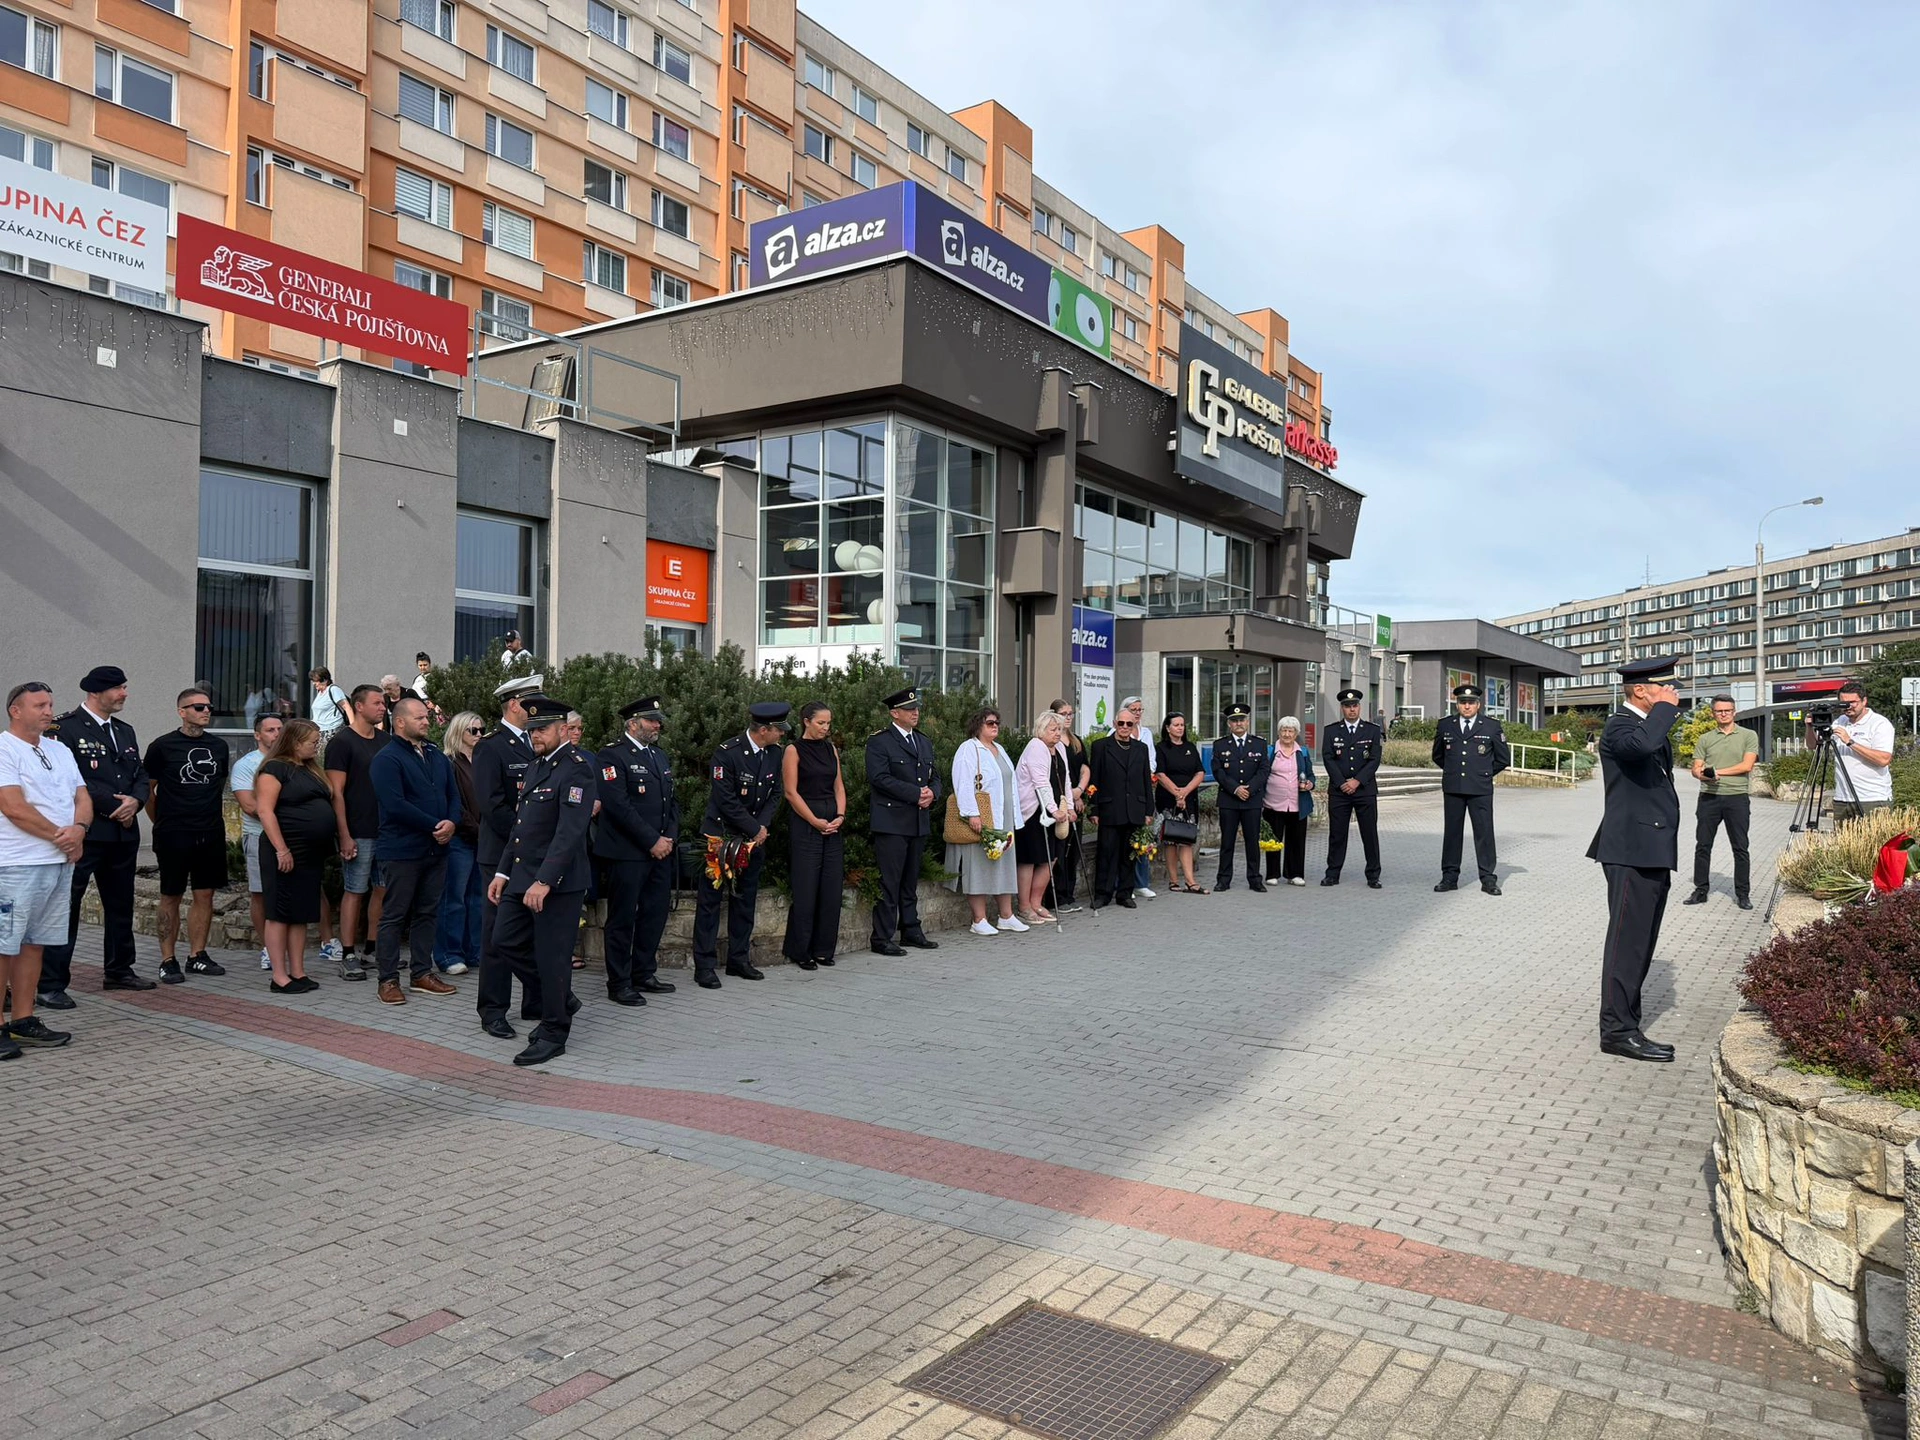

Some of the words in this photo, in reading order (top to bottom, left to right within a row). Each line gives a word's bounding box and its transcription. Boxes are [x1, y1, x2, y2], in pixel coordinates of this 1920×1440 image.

[0, 219, 82, 252] ZÁKAZNICKÉ
[86, 245, 145, 269] CENTRUM
[97, 208, 146, 247] ČEZ
[804, 218, 886, 256] alza.cz
[278, 266, 372, 311] GENERALI
[970, 245, 1025, 292] alza.cz
[277, 287, 340, 324] ČESKÁ
[344, 309, 450, 356] POJIŠŤOVNA
[1224, 377, 1285, 427] GALERIE
[1236, 417, 1283, 459] POŠTA
[648, 585, 681, 598] SKUPINA
[682, 588, 696, 600] ČEZ
